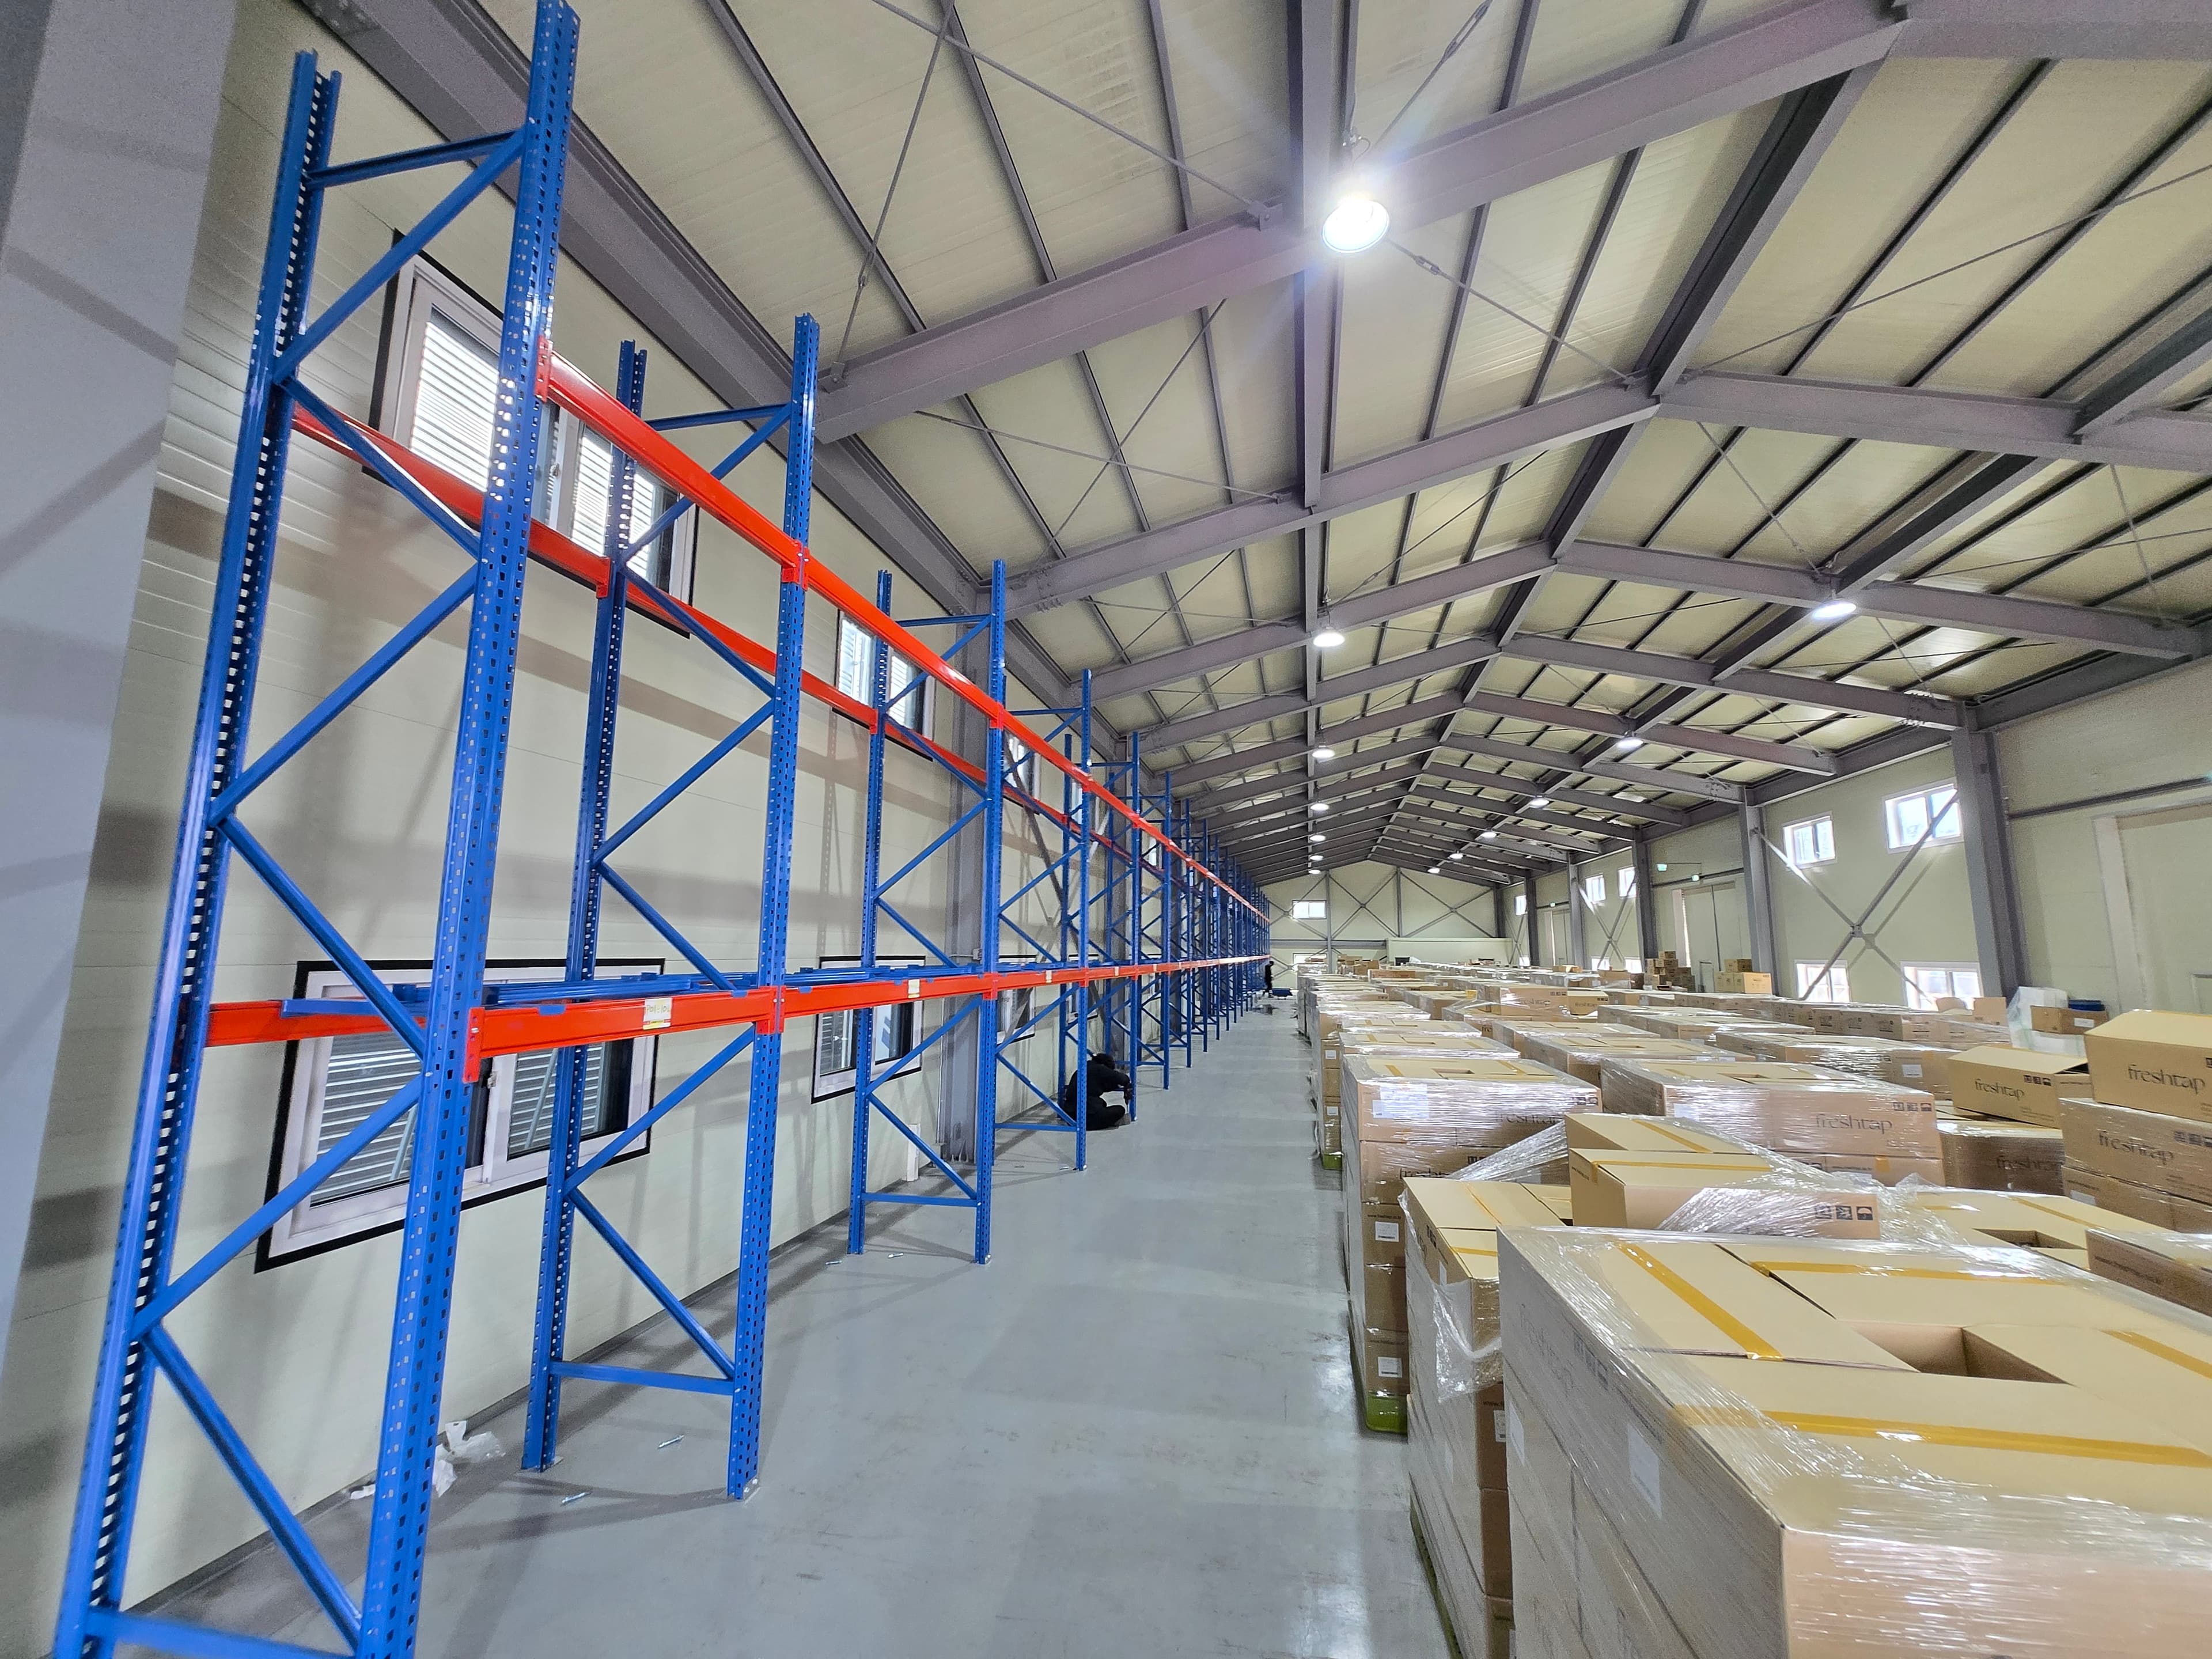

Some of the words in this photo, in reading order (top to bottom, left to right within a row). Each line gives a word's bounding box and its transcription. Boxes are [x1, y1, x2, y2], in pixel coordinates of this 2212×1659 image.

[1975, 1078, 2025, 1102] freshtap
[2128, 1064, 2206, 1095] freshtap
[1816, 1113, 1892, 1134] freshtap
